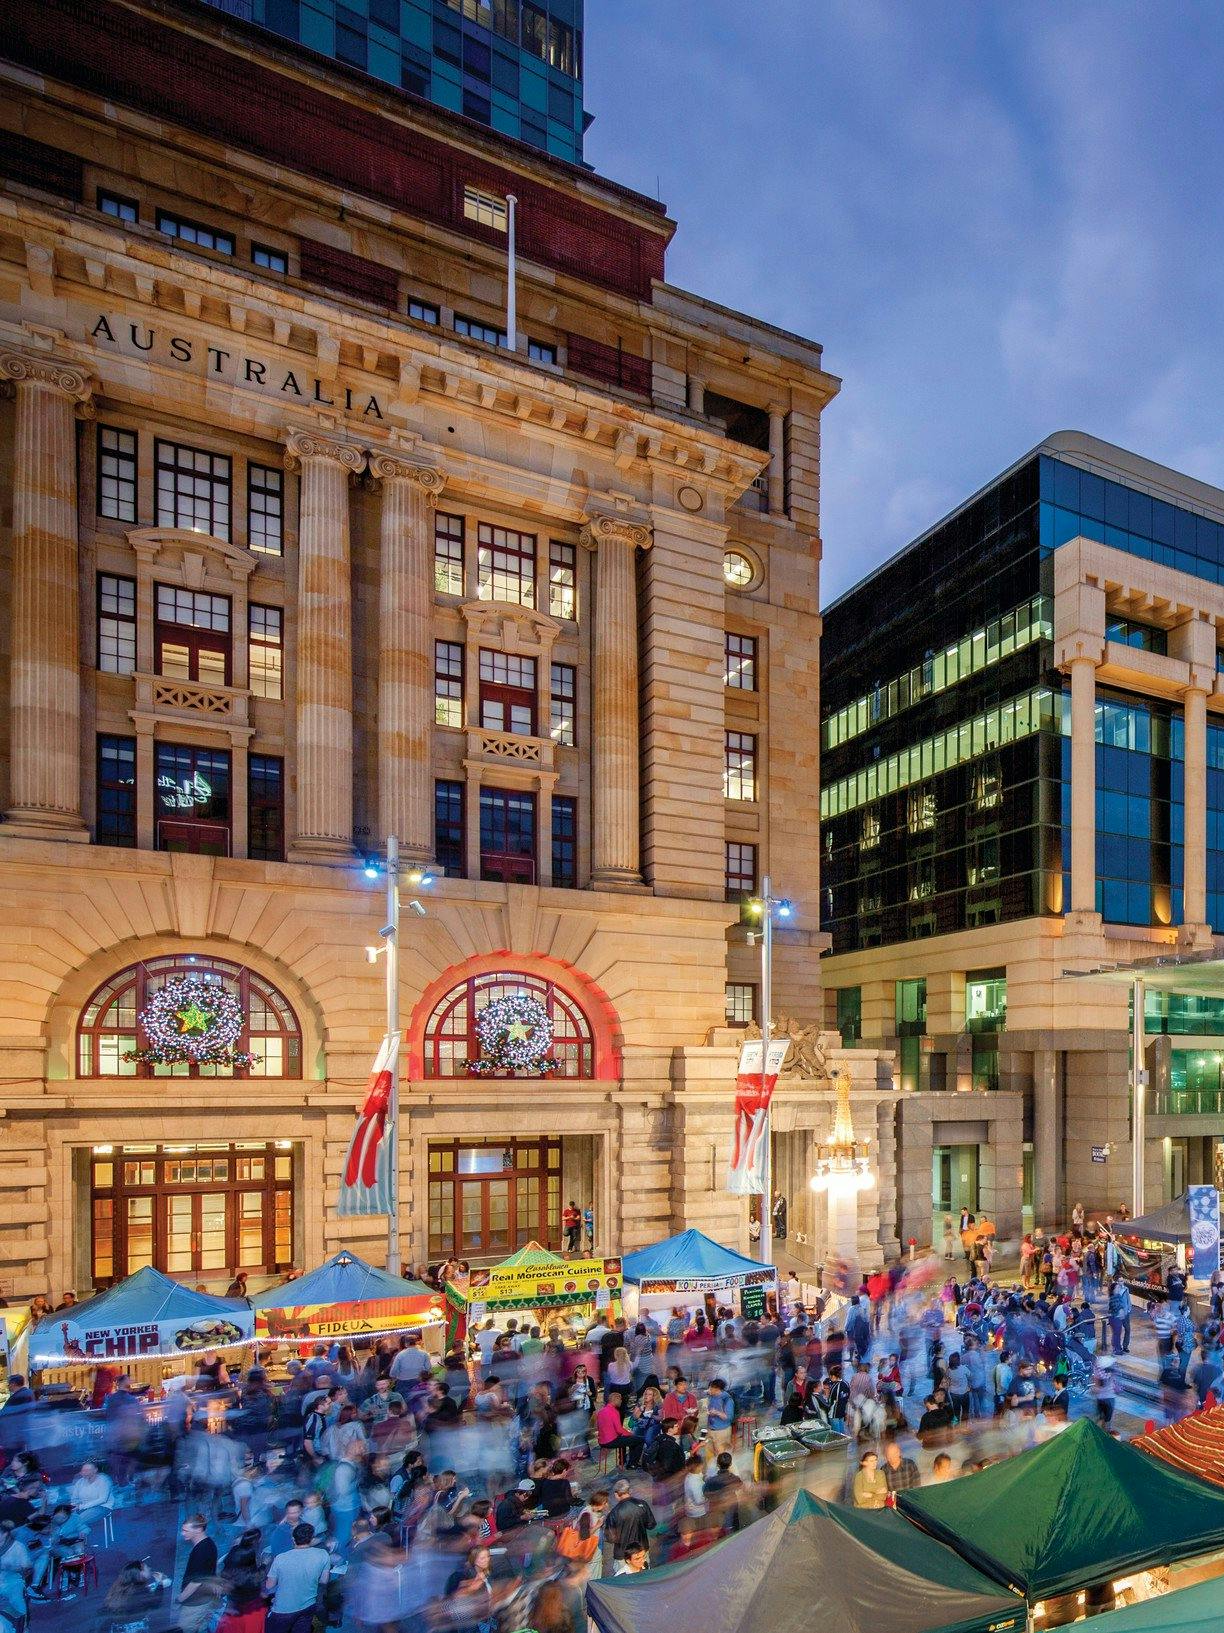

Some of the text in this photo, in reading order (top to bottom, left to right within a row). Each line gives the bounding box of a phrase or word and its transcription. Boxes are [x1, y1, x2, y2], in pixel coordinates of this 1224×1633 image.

[91, 315, 386, 420] AUSTRALIA
[492, 1273, 514, 1282] Real
[517, 1270, 564, 1280] Moroccan
[567, 1267, 602, 1276] Cuisine
[725, 1276, 744, 1287] FOOD
[85, 1324, 159, 1340] NEW YORKER
[85, 1333, 159, 1359] CHIP
